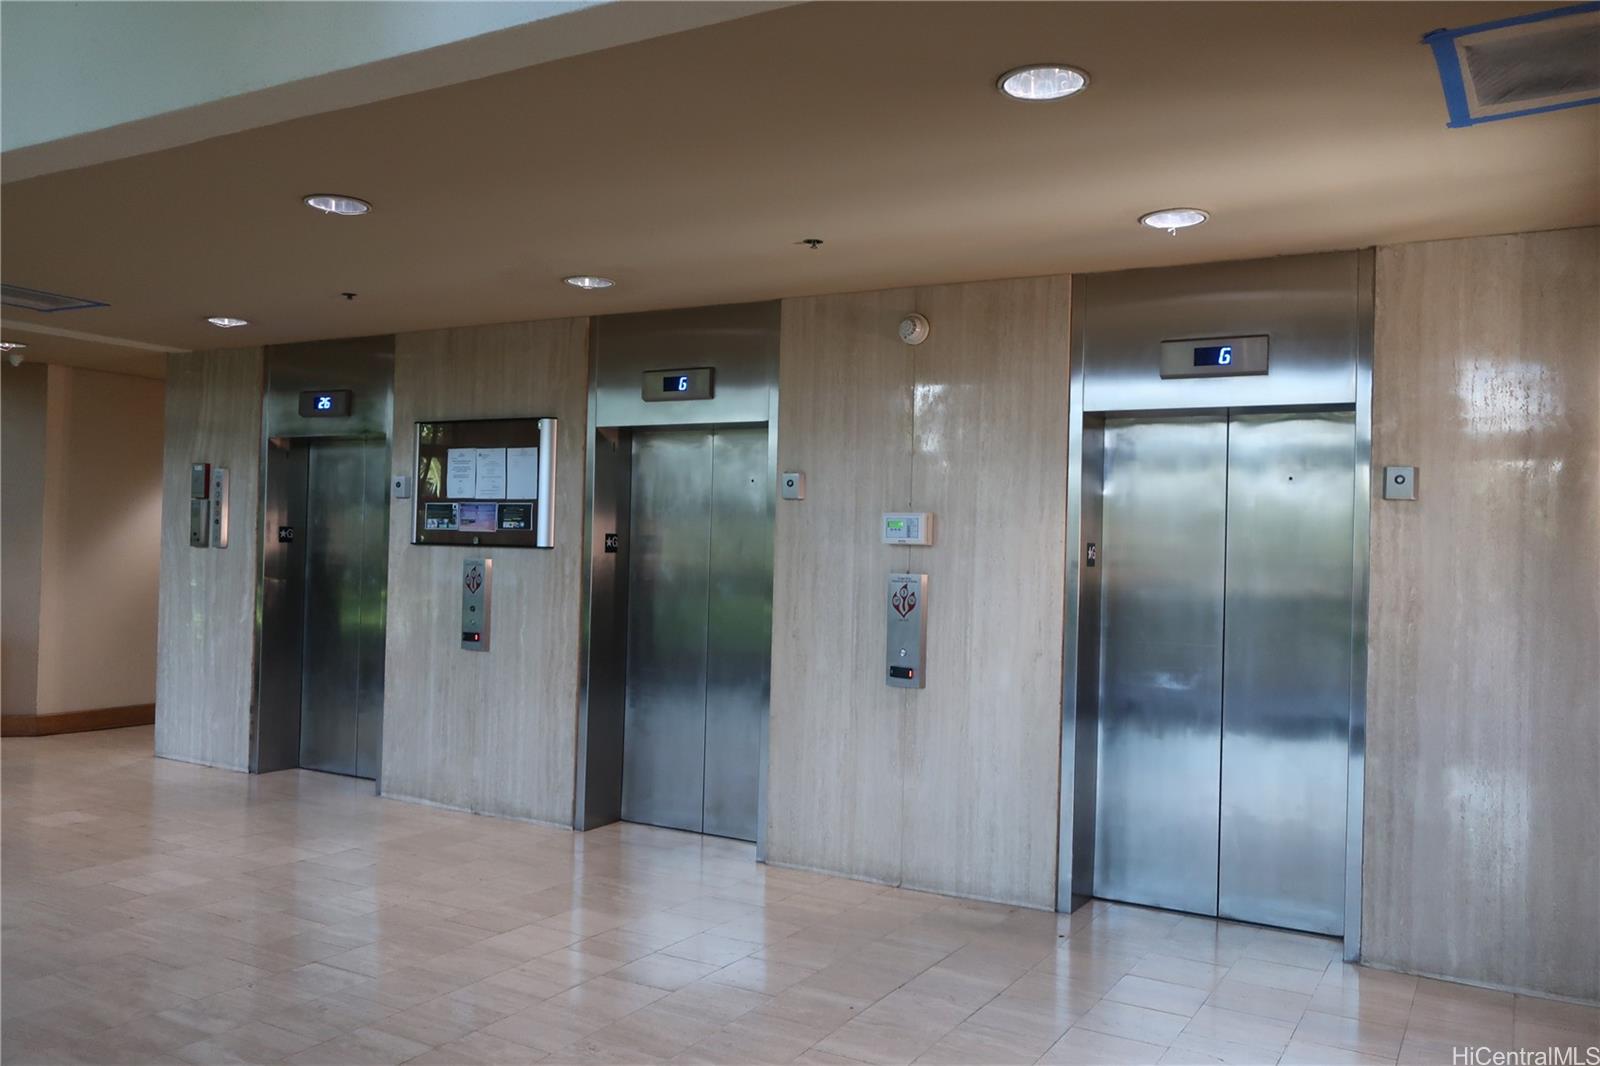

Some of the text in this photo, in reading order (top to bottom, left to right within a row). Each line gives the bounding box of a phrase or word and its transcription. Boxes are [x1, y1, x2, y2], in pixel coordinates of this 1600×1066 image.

[1218, 347, 1231, 365] G
[678, 376, 687, 391] G
[317, 397, 331, 409] 26
